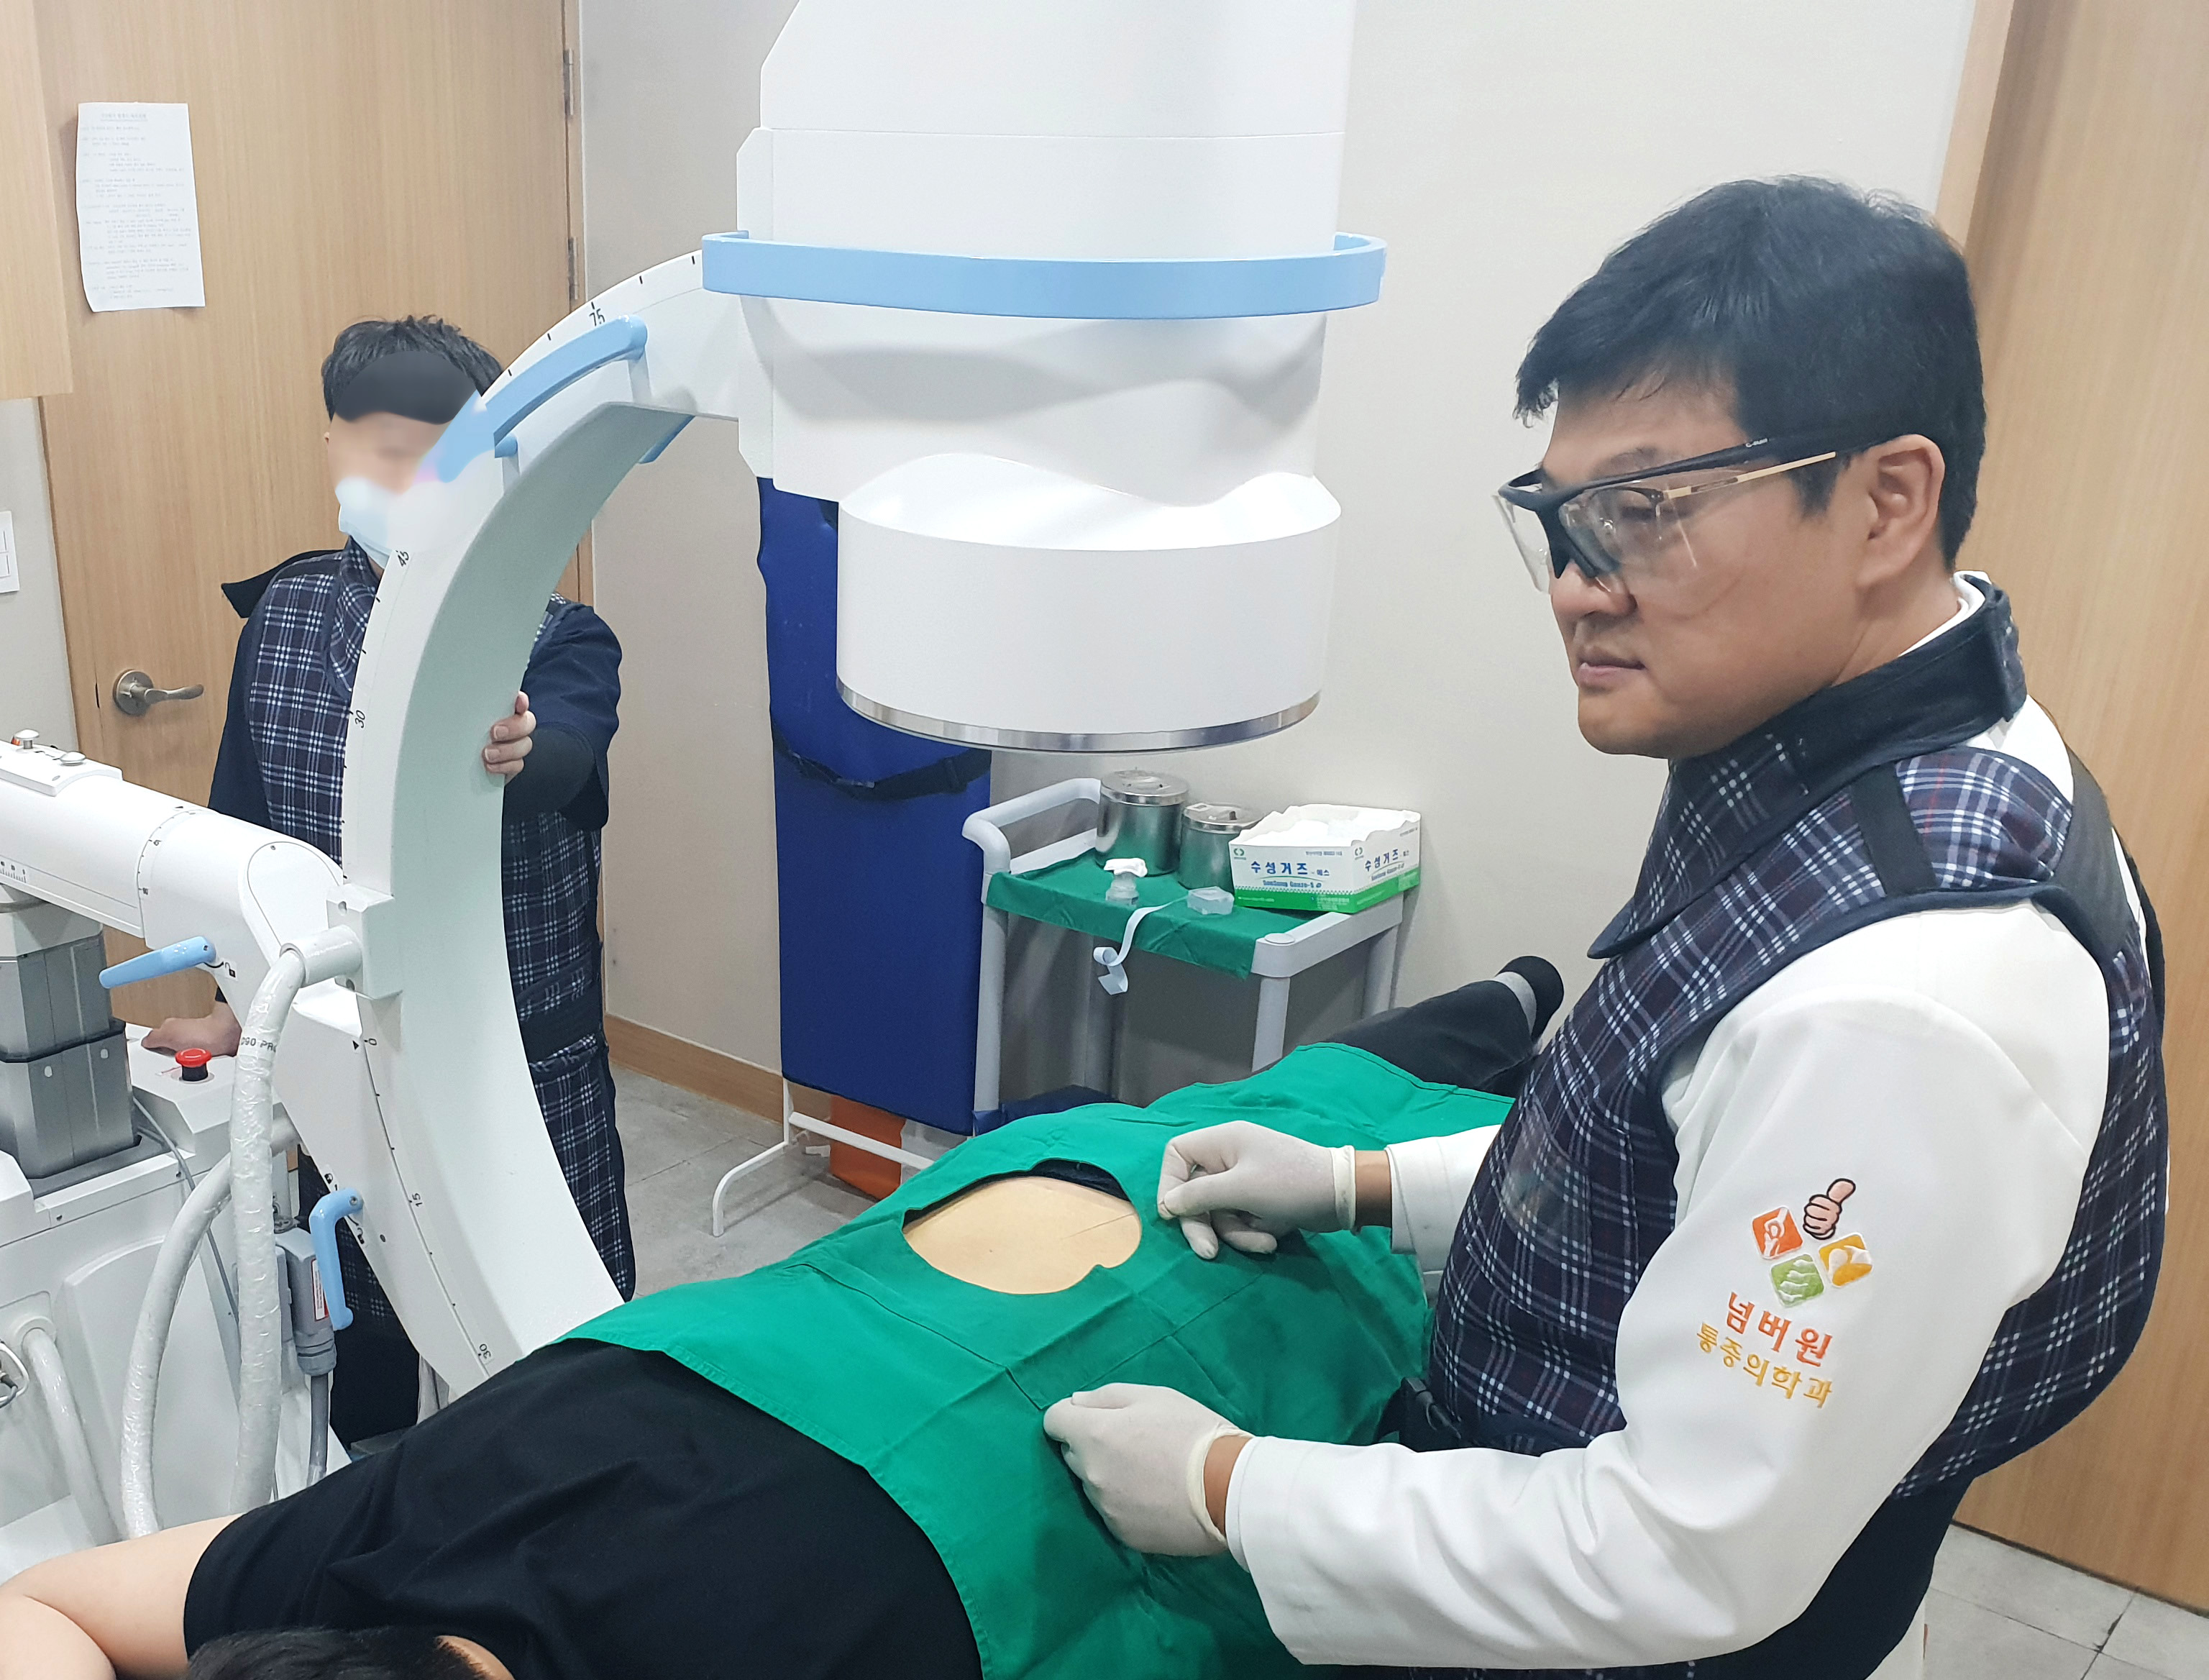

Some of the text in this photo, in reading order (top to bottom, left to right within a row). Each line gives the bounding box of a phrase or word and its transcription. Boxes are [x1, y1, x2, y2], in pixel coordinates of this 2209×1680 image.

[589, 309, 605, 327] 75
[398, 552, 409, 567] 45
[355, 710, 365, 729] 30
[1251, 861, 1308, 875] 수성거즈
[412, 1192, 423, 1208] 15
[1727, 1292, 1833, 1367] 넘버원
[479, 1343, 491, 1359] 30
[1696, 1323, 1833, 1409] 통증의학과
